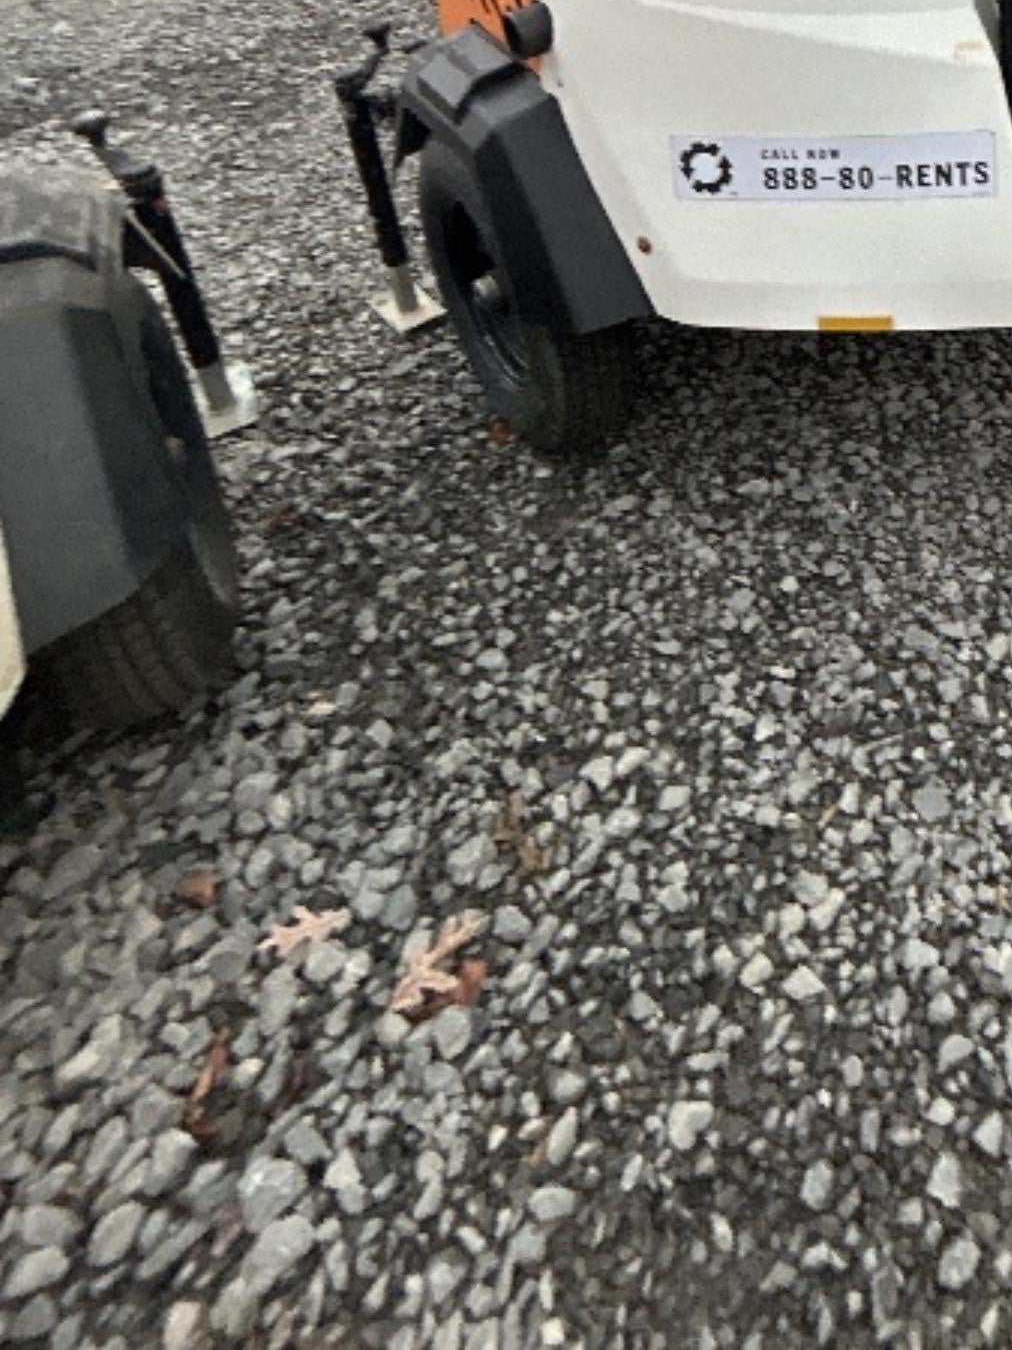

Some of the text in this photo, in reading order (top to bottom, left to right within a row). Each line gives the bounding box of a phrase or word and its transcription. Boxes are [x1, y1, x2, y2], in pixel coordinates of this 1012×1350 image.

[761, 148, 840, 161] CALL NOW
[763, 161, 990, 191] 888-80-RENTS
